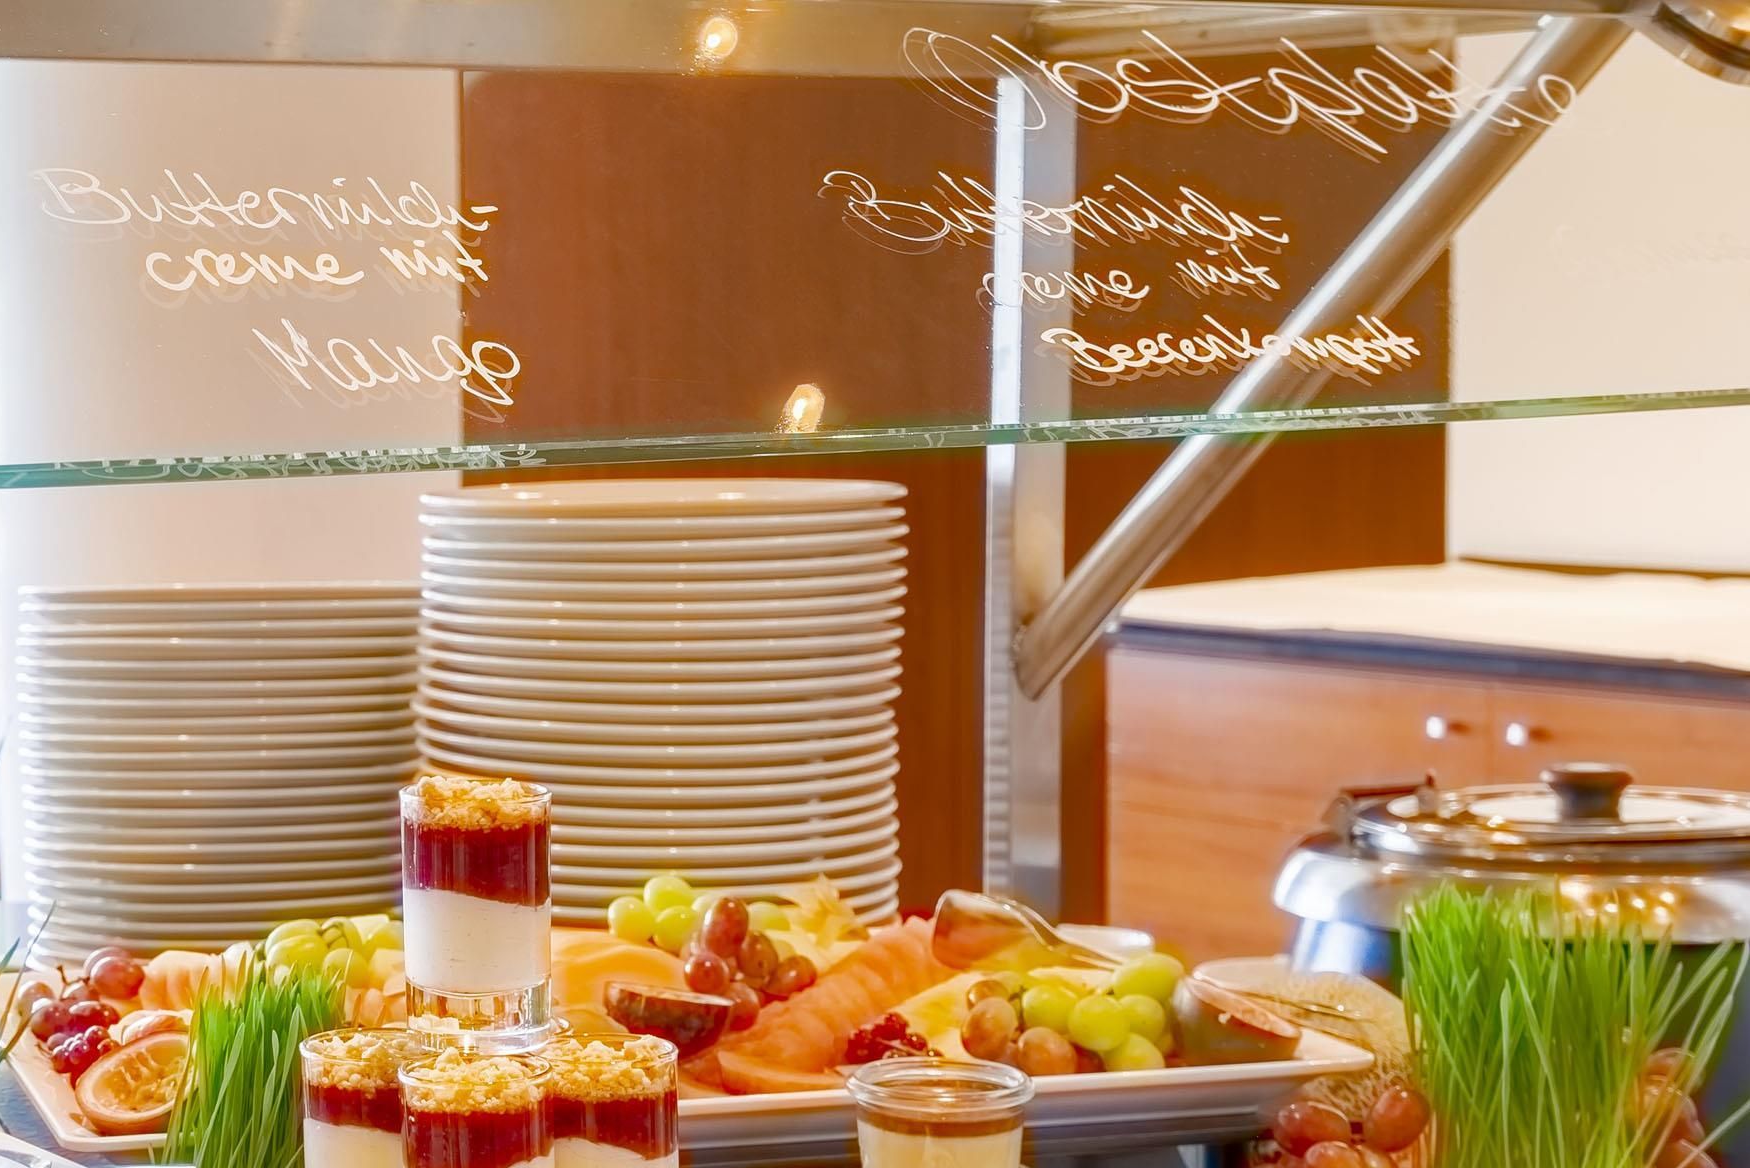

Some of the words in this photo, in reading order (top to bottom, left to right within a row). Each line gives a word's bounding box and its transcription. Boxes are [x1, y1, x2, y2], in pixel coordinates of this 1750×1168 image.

[145, 247, 365, 292] creme
[379, 230, 490, 282] mit
[1175, 243, 1281, 291] mit
[251, 317, 522, 405] Mango
